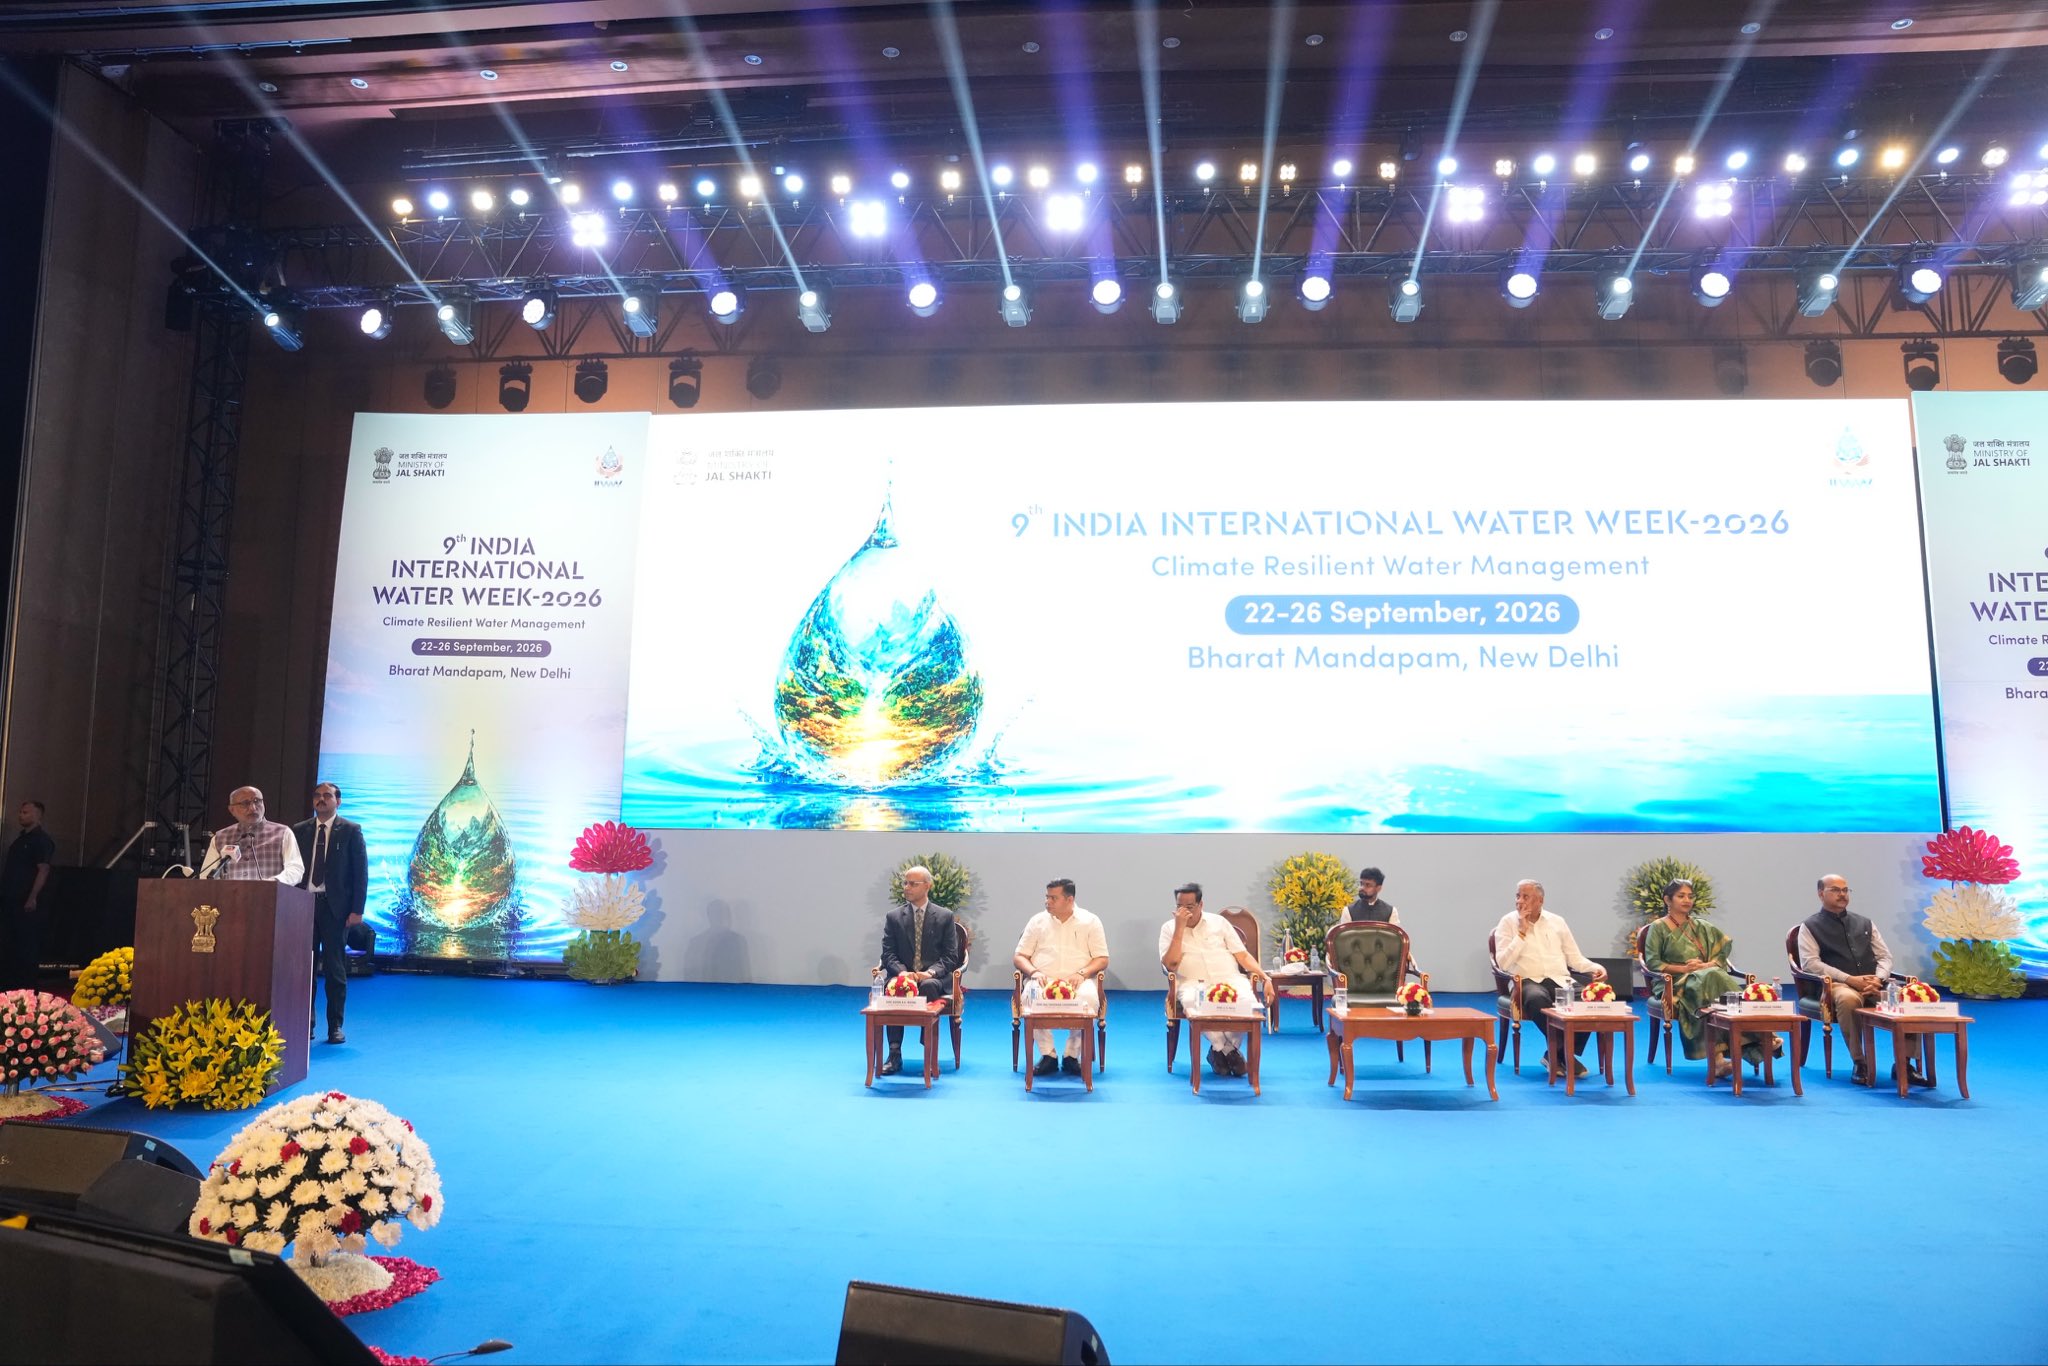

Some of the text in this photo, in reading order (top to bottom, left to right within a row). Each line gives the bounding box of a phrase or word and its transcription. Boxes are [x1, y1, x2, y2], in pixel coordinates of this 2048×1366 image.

[1973, 449, 2028, 458] MINISTRY OF
[397, 461, 445, 469] MINISTRY OF
[1973, 458, 2031, 467] JAL SHAKTI
[395, 469, 445, 477] JAL SHAKTI
[705, 470, 772, 482] JAL SHAKTI
[1011, 503, 1789, 538] 9th INDIA INTERNATIONAL WATER WEEK-2026
[442, 533, 536, 556] 9th INDIA
[391, 559, 584, 580] INTERNATIONAL
[1151, 554, 1650, 582] Climate Resilient Water Management
[372, 585, 602, 608] WATER WEEK-2026
[1244, 599, 1561, 630] 22-26 September, 2026
[382, 616, 586, 632] Climate Resilient Water Management
[1988, 634, 2039, 645] Climate
[420, 641, 543, 655] 22-26 September, 2026
[1188, 644, 1619, 676] Bharat Mandapam, New Delhi
[388, 664, 571, 681] Bharat Mandapam, New Delhi
